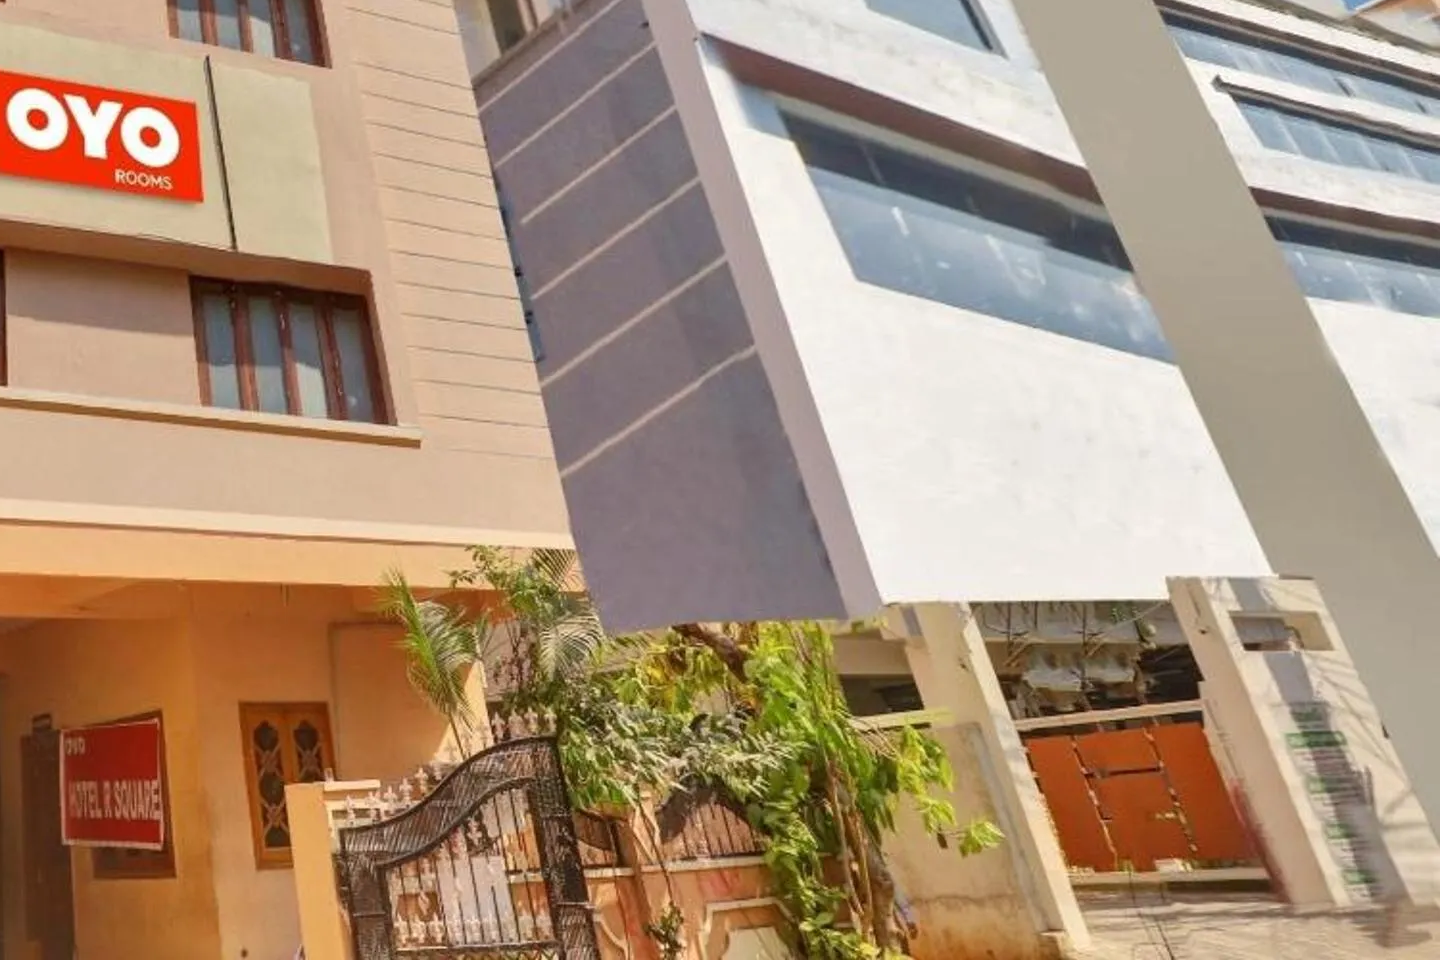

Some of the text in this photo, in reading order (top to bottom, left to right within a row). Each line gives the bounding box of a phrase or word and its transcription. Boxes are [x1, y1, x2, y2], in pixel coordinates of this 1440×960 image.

[6, 88, 180, 168] OYO
[115, 168, 173, 191] ROOMS
[68, 780, 102, 819] HOTEL
[113, 779, 161, 822] SQUARE
